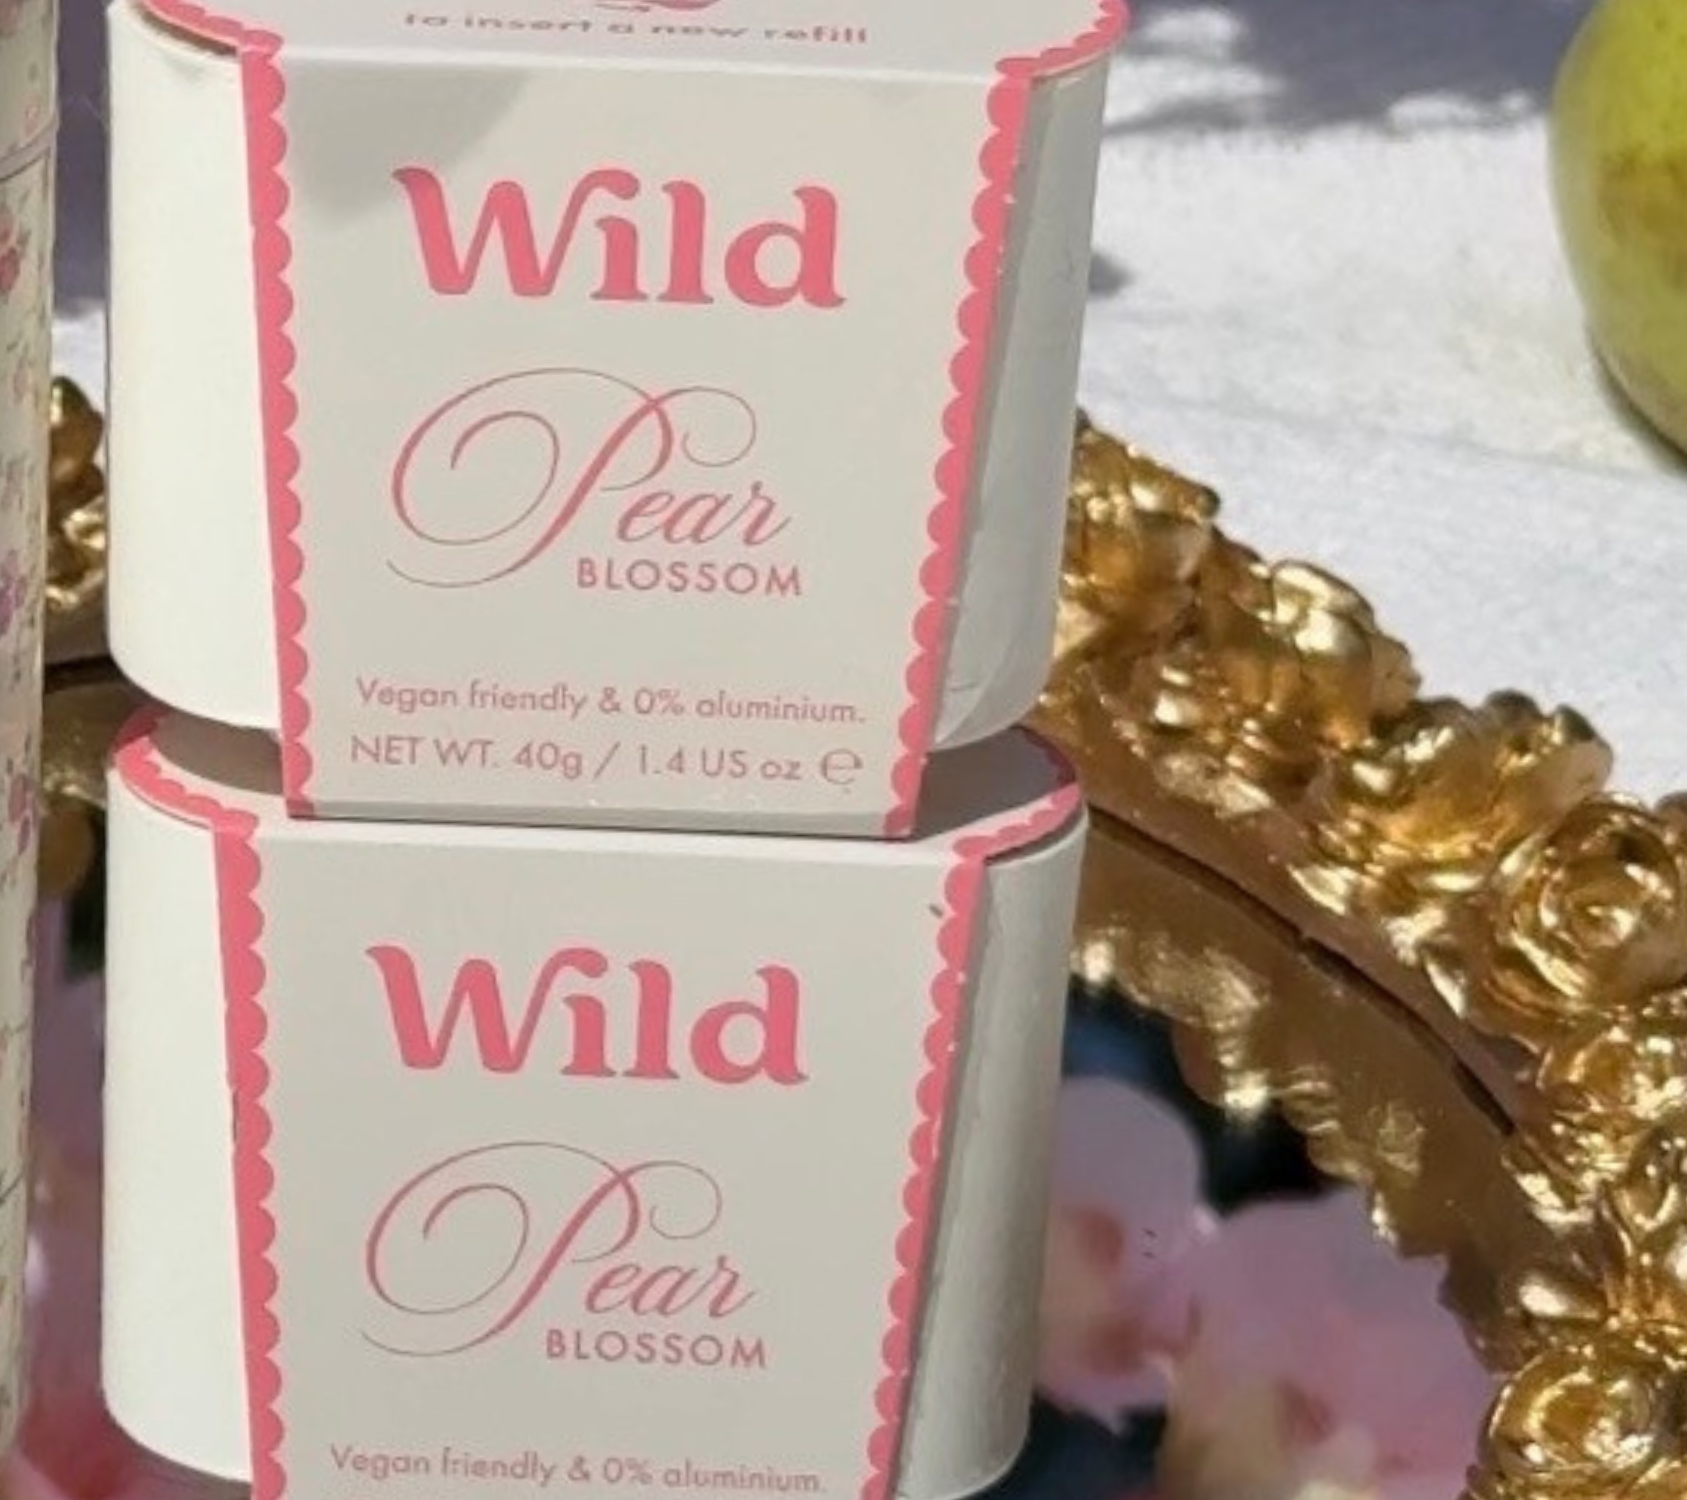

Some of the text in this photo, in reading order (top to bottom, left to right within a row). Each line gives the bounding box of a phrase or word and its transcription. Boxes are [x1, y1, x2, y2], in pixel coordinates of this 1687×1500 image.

[405, 13, 867, 44] to insert a new refill
[393, 166, 846, 309] Wild
[386, 366, 792, 589] Pear
[576, 556, 803, 598] BLOSSOM
[356, 677, 866, 724] Vegan friendly & 0% aluminium.
[350, 734, 425, 766] NET
[433, 737, 500, 768] WT.
[512, 740, 583, 780] 40g
[593, 741, 621, 780] /
[639, 743, 686, 776] 1.4
[700, 748, 748, 779] US
[760, 759, 802, 780] oz
[365, 944, 810, 1086] Wild
[361, 1140, 757, 1358] Pear
[545, 1328, 767, 1369] BLOSSOM
[330, 1443, 431, 1482] Vegan
[440, 1446, 557, 1488] friendly
[568, 1454, 591, 1482] &
[603, 1457, 653, 1485] 0%
